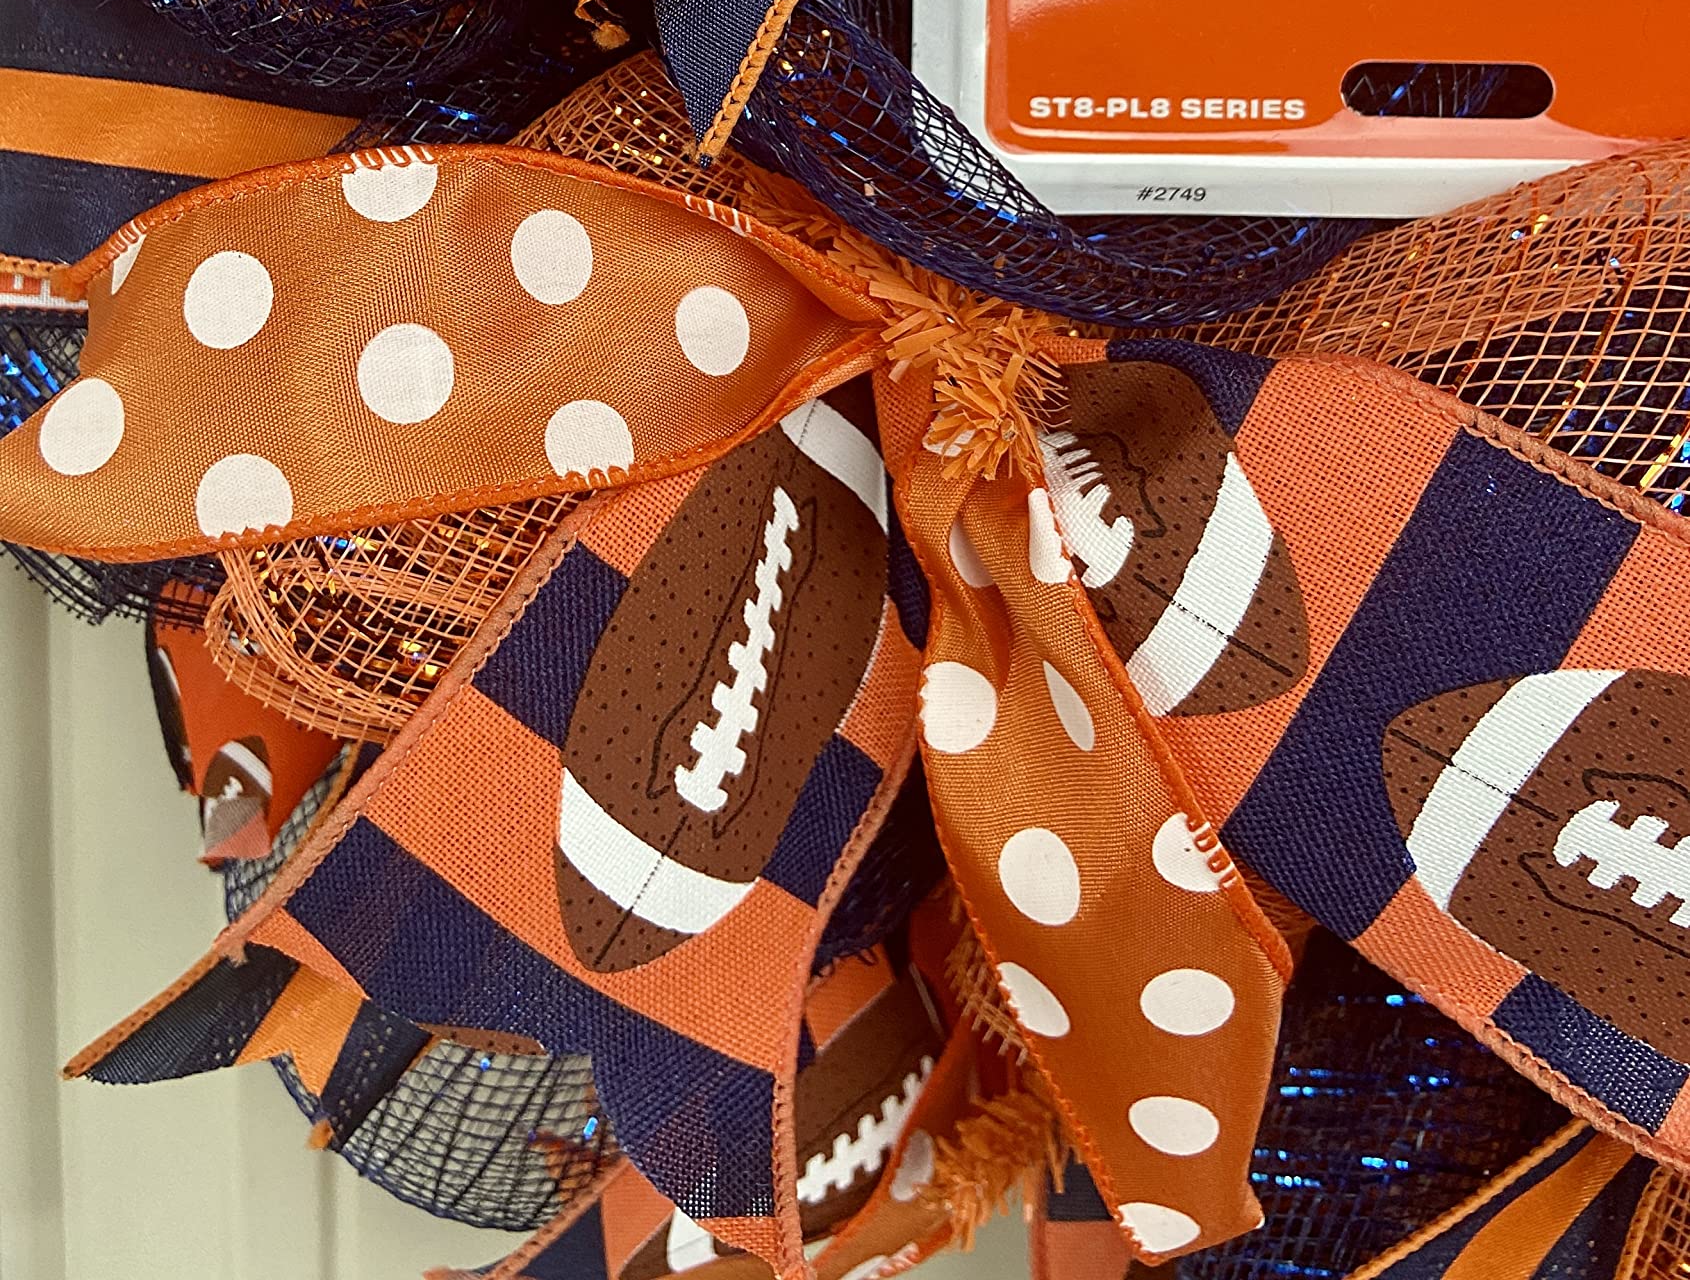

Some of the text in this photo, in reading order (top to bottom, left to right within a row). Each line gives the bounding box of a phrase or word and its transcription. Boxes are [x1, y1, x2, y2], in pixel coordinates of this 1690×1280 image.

[1029, 96, 1306, 120] ST8-PL8 SERIES
[1136, 186, 1207, 202] #2749
